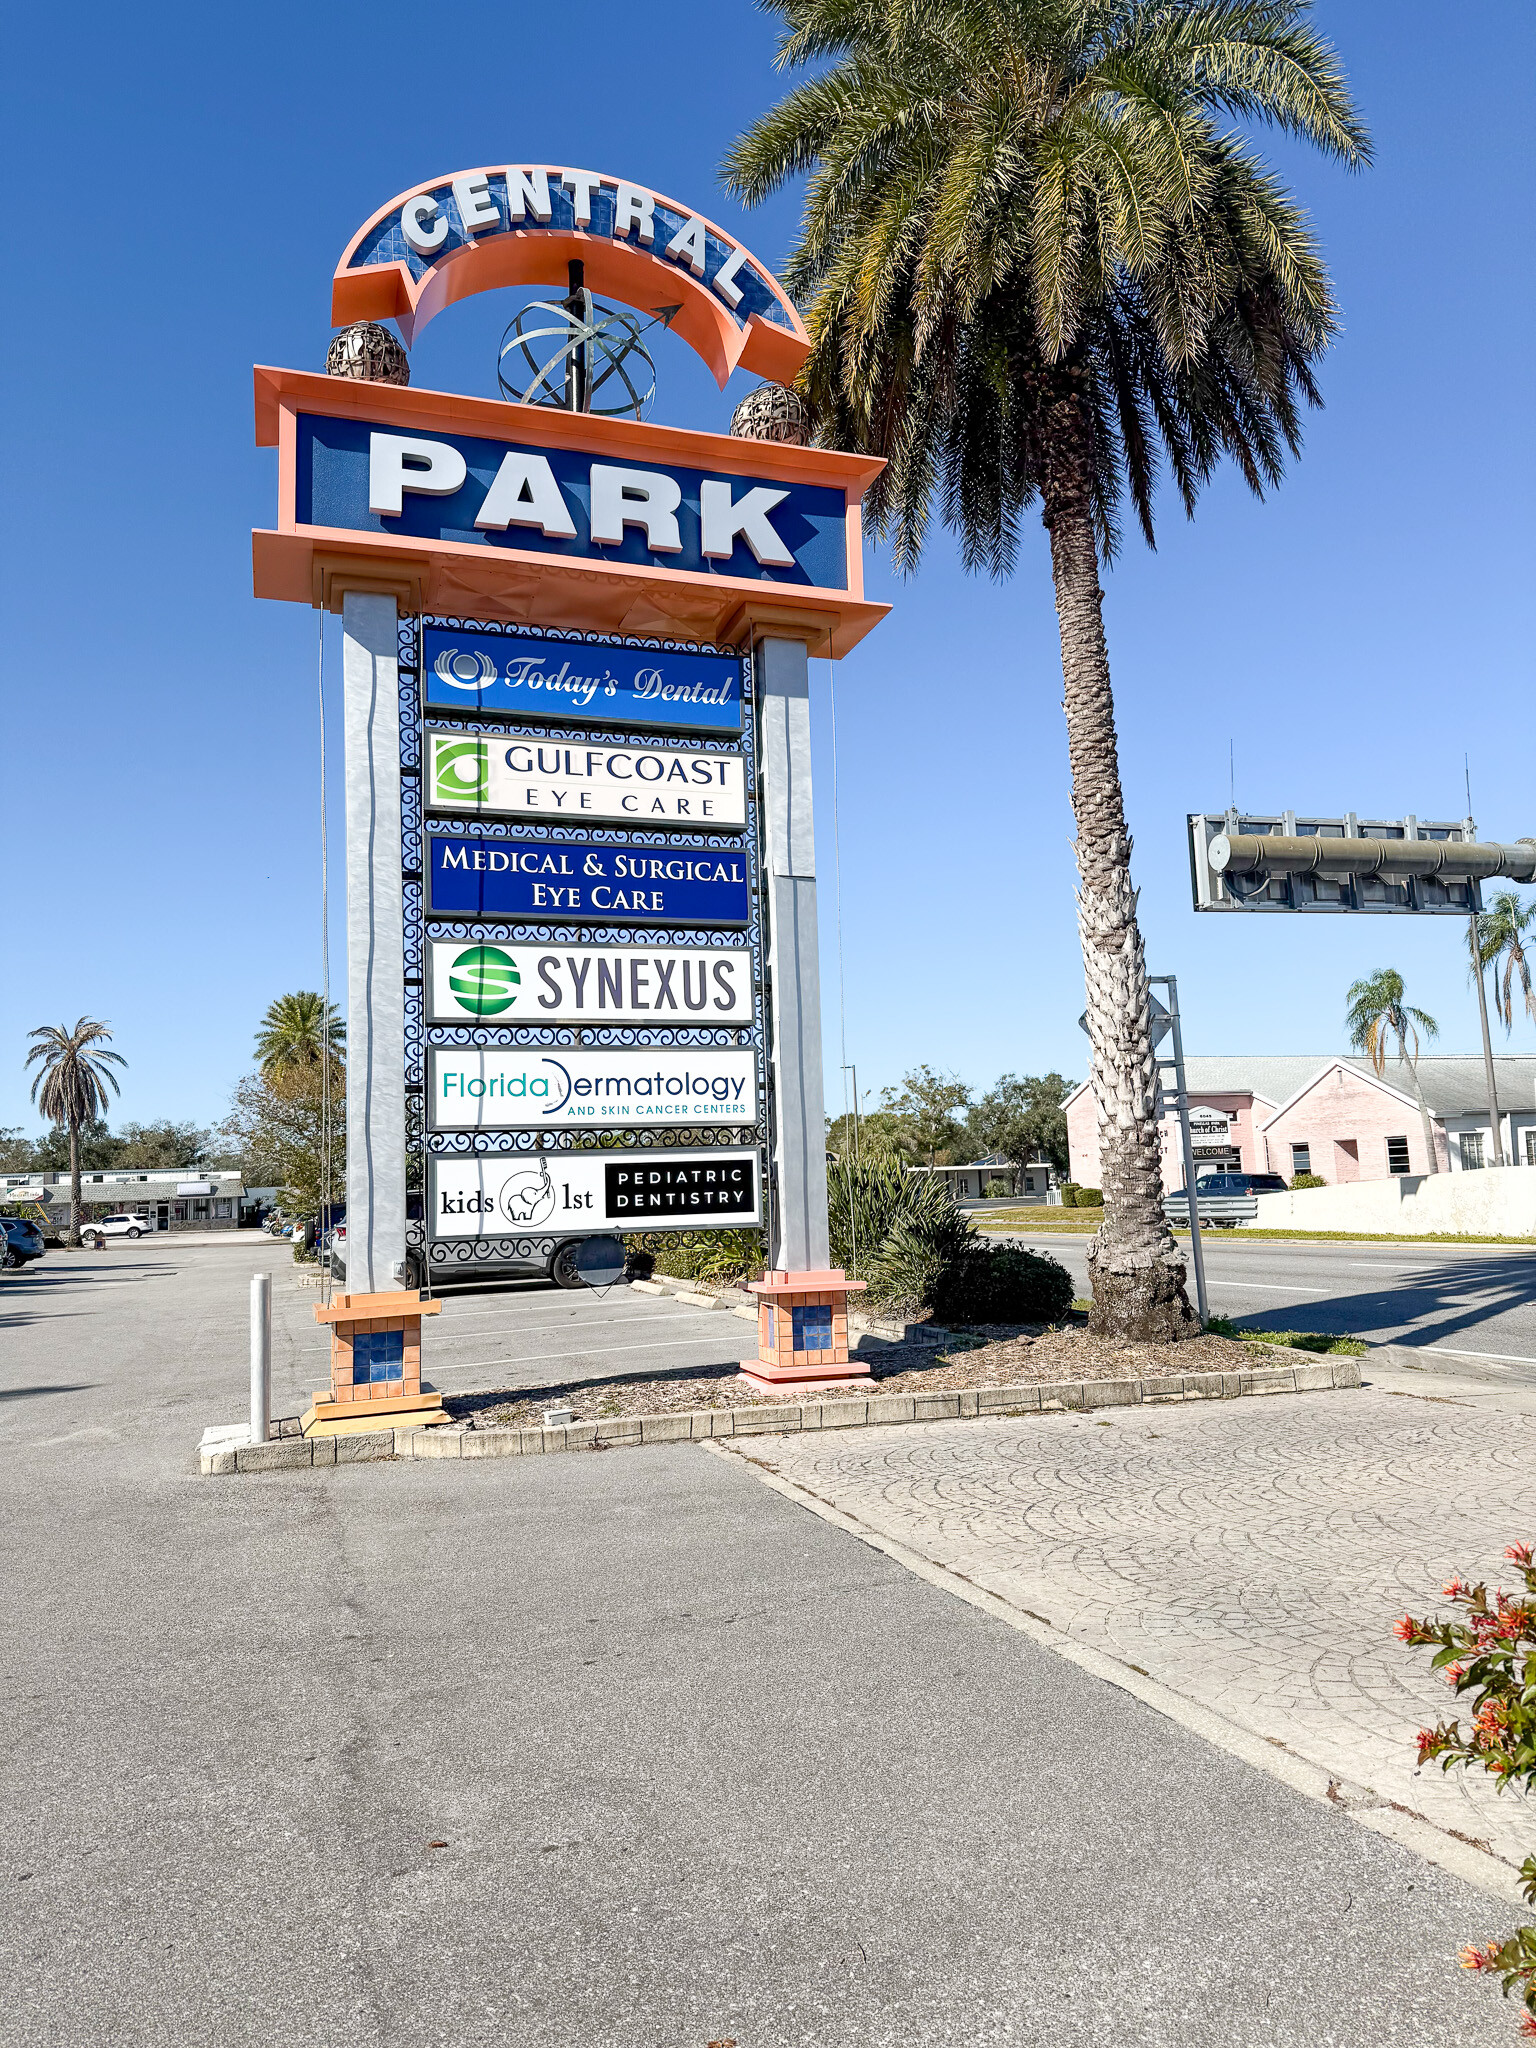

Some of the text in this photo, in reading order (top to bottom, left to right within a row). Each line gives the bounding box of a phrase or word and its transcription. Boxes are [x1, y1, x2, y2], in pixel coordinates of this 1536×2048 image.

[401, 168, 749, 310] CENTRAL
[369, 431, 796, 568] PARK
[504, 656, 734, 706] Today's Dental
[504, 746, 731, 786] GULFCOAST
[526, 788, 714, 816] EYE CARE
[441, 845, 744, 883] MEDICAL & SURGICAL
[532, 883, 664, 911] EYE CARE
[537, 956, 737, 1011] SYNEXUS
[443, 1058, 746, 1115] Florida Dermatology
[567, 1103, 746, 1116] AND SKIN CANCER CENTERS
[618, 1168, 742, 1185] PEDIATRIC
[440, 1183, 594, 1215] kids 1st
[617, 1190, 745, 1208] DENTISTRY
